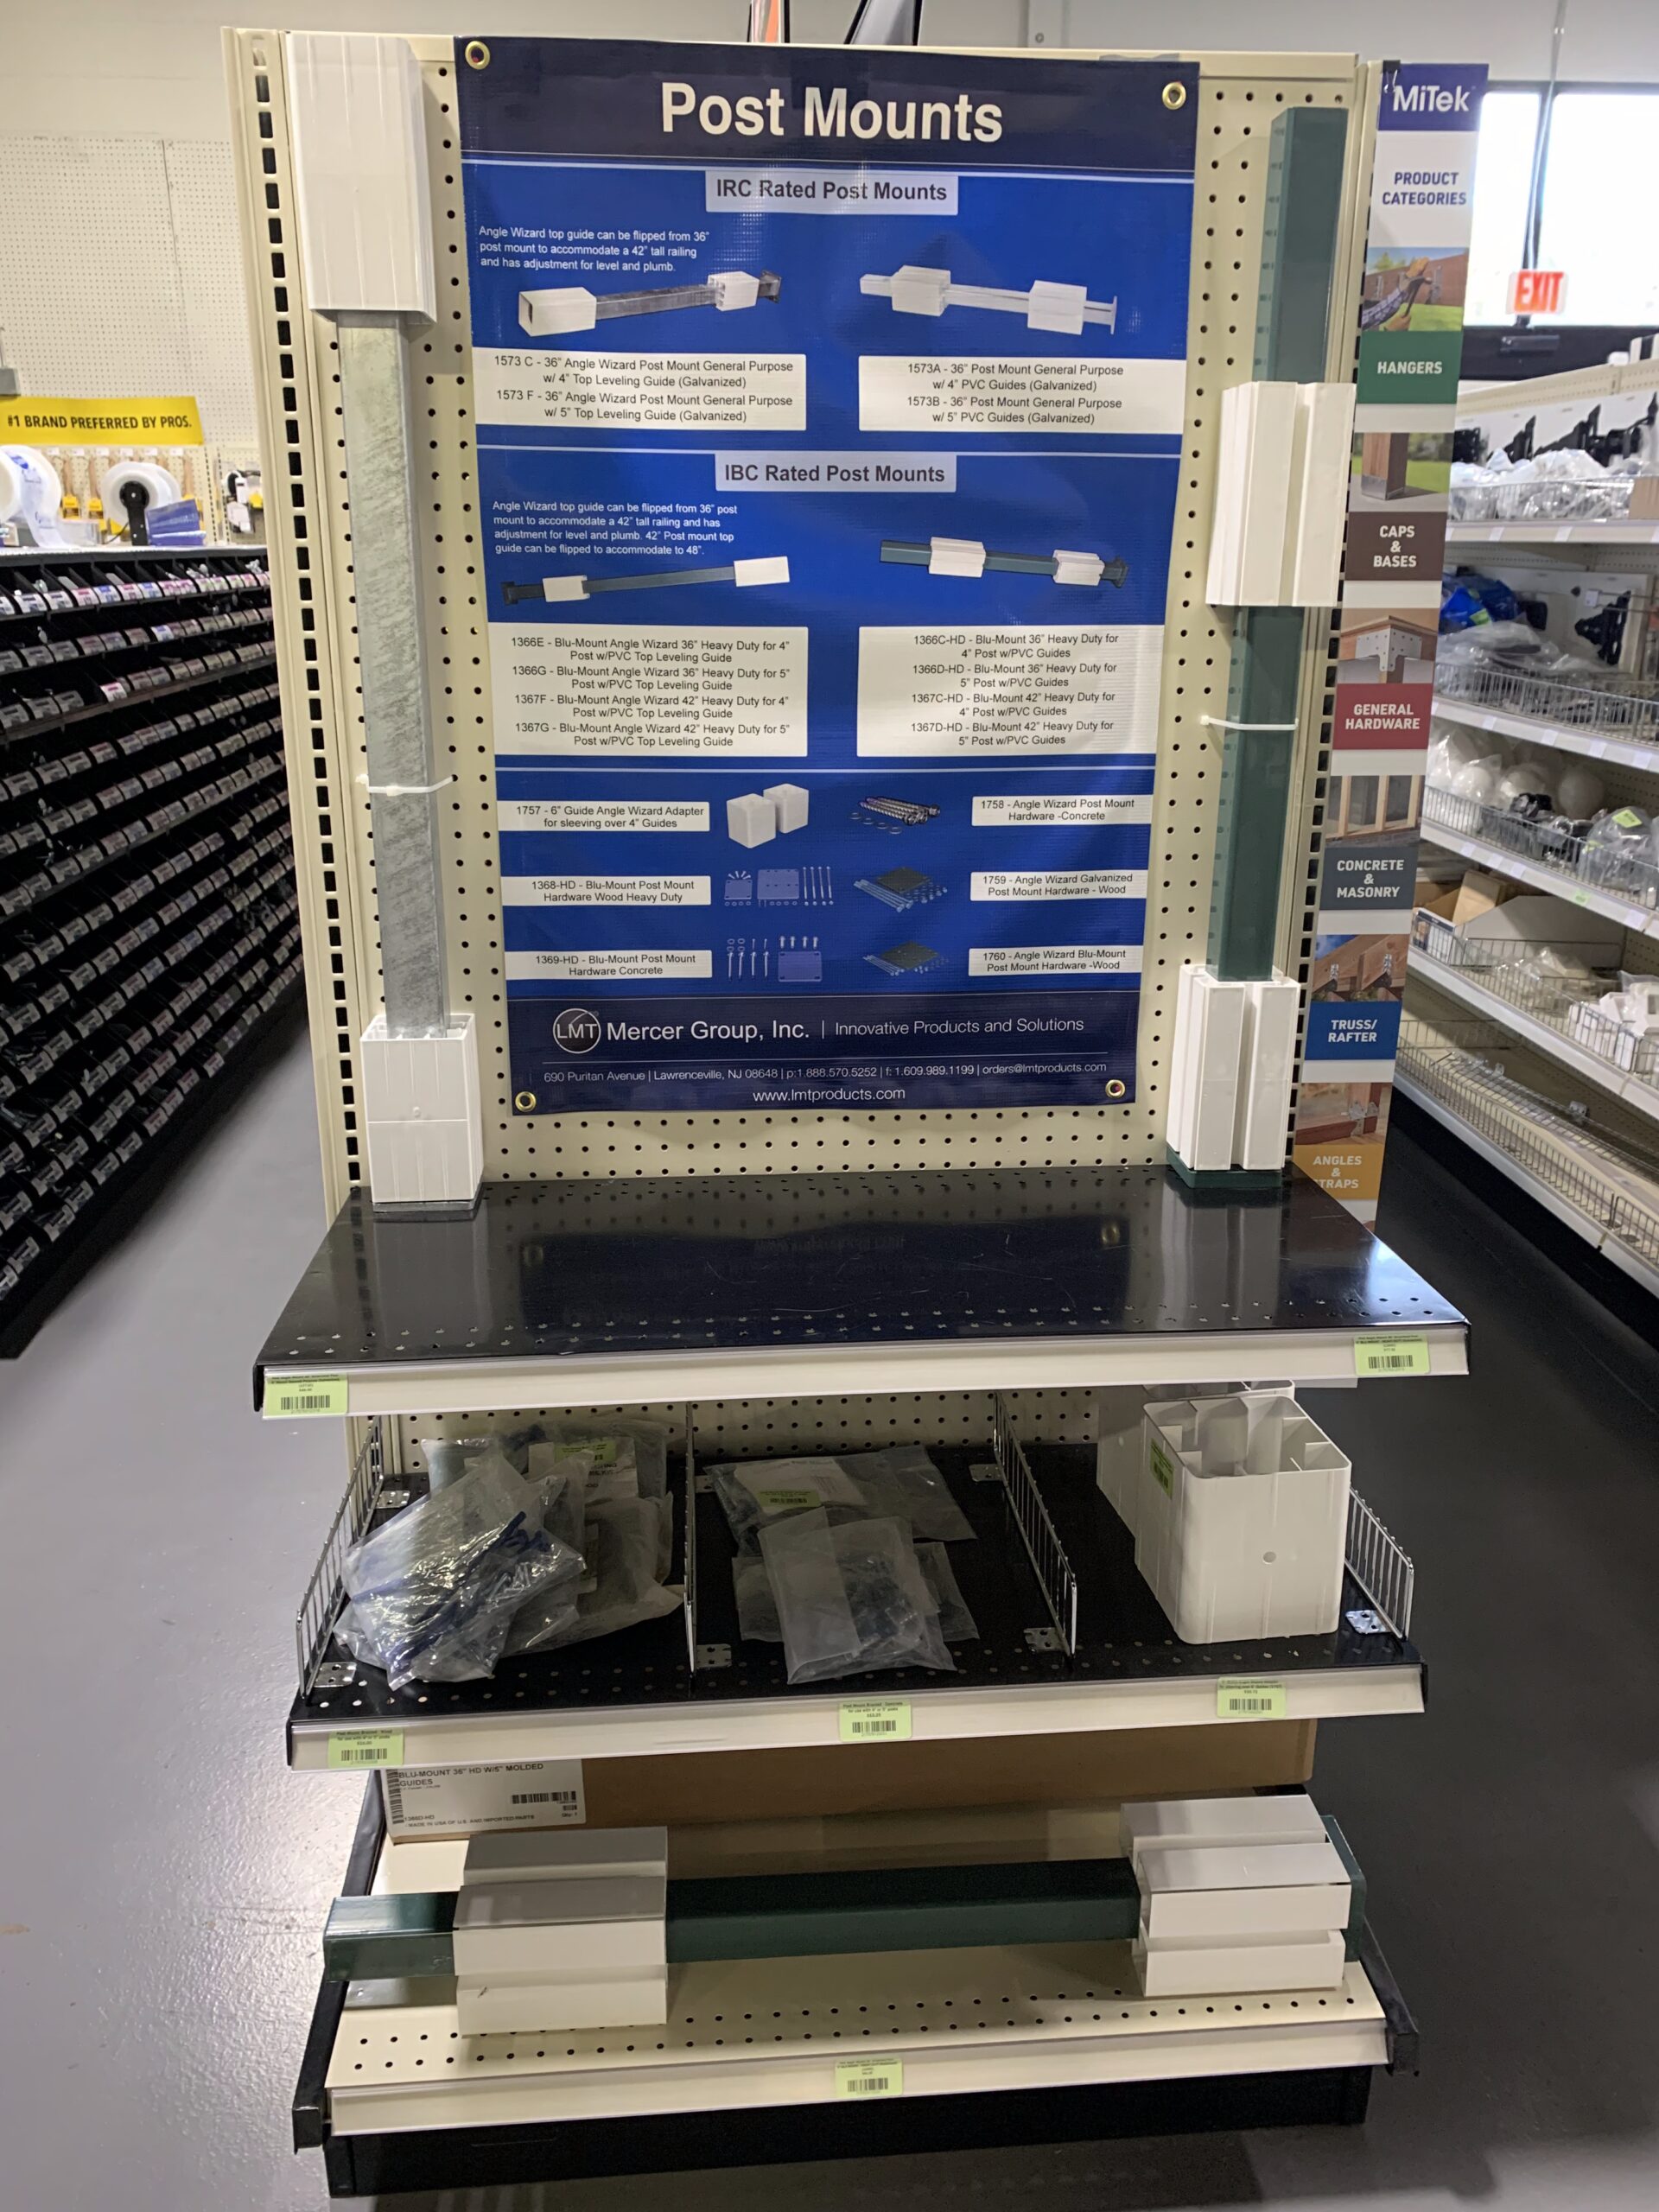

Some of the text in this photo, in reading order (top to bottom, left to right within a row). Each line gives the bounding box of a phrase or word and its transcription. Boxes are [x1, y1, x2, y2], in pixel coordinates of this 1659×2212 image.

[1393, 85, 1471, 112] MiTek
[661, 81, 1002, 143] Post Mounts
[1394, 171, 1459, 186] PRODUCT
[716, 178, 947, 200] IRC Rated Post Mounts
[1382, 192, 1467, 206] CATEGORIES
[478, 225, 508, 239] Angle
[509, 226, 546, 238] Wizard
[548, 228, 564, 241] top
[566, 228, 594, 242] guide
[596, 231, 615, 240] can
[617, 229, 631, 240] be
[632, 229, 666, 243] flipped
[668, 230, 690, 242] from
[1514, 270, 1564, 312] EXIT
[493, 354, 522, 366] 1573
[524, 355, 533, 367] C
[563, 357, 595, 372] Angle
[598, 359, 636, 370] Wizard
[639, 359, 664, 371] Post
[666, 359, 700, 371] Mount
[702, 359, 746, 372] General
[748, 359, 793, 373] Purpose
[908, 362, 941, 373] 1573A
[970, 363, 995, 374] Post
[997, 363, 1031, 375] Mount
[1033, 363, 1077, 375] General
[1079, 364, 1124, 377] Purpose
[1376, 361, 1443, 374] HANGERS
[542, 372, 556, 383] w/
[572, 372, 592, 386] Top
[595, 375, 640, 389] Leveling
[642, 375, 676, 386] Guide
[677, 375, 747, 389] (Galvanized)
[8, 415, 192, 429] #1 BRAND PREFERRED BY PROS.
[725, 463, 944, 482] IBC Rated Post Mounts
[1379, 524, 1415, 537] CAPS
[1390, 541, 1402, 553] &
[1373, 555, 1417, 568] BASES
[511, 636, 544, 647] 1366E
[554, 637, 607, 648] Blu-Mount
[609, 638, 639, 651] Angle
[641, 639, 678, 649] Wizard
[701, 639, 734, 652] Heavy
[735, 639, 760, 653] Duty
[762, 640, 777, 651] for
[913, 634, 966, 645] 1366C-HD
[975, 633, 1026, 645] Blu-Mount
[1047, 633, 1078, 646] Heavy
[1080, 632, 1103, 645] Duty
[1104, 632, 1119, 643] for
[569, 649, 732, 664] Post w/PVC Top Leveling Guide
[974, 647, 997, 658] Post
[998, 647, 1033, 658] w/PVC
[1036, 647, 1071, 658] Guides
[1353, 703, 1414, 715] GENERAL
[1344, 717, 1421, 729] HARDWARE
[981, 798, 1135, 811] 1758 Angle Wizard Post Mount
[1007, 810, 1055, 821] Hardware
[1337, 859, 1405, 871] CONCRETE
[531, 880, 694, 890] 1368-HD Blu-Mount Post Mount
[1363, 873, 1375, 885] &
[543, 892, 683, 904] Hardware Wood Heavy Duty
[1337, 887, 1401, 899] MASONRY
[982, 948, 1126, 962] 1760 Angle Wizard Blu-Mount
[986, 963, 1008, 972] Post
[1009, 960, 1039, 971] Mount
[1041, 961, 1087, 970] Hardware
[556, 1023, 598, 1039] LMT
[607, 1019, 809, 1043] Mercer Group, Inc.
[835, 1016, 1084, 1035] Innovative Products and Solutions
[1331, 1019, 1378, 1030] TRUSS/
[1327, 1032, 1377, 1042] RAFTER
[543, 1071, 566, 1083] 690
[568, 1070, 604, 1082] Puritan
[606, 1070, 645, 1081] Avenue
[653, 1069, 725, 1081] Lawrenceville,
[727, 1068, 742, 1079] NJ
[744, 1067, 779, 1079] 08648
[885, 1065, 892, 1077] f:
[982, 1062, 1107, 1074] orders@lmtproducts.com
[752, 1087, 906, 1102] www.lmtproducts.com
[1313, 1155, 1363, 1166] ANGLES
[1331, 1167, 1341, 1177] &
[398, 1769, 450, 1778] BLU-MOUNT
[505, 1763, 544, 1772] MOLDED
[399, 1778, 434, 1787] GUIDES
